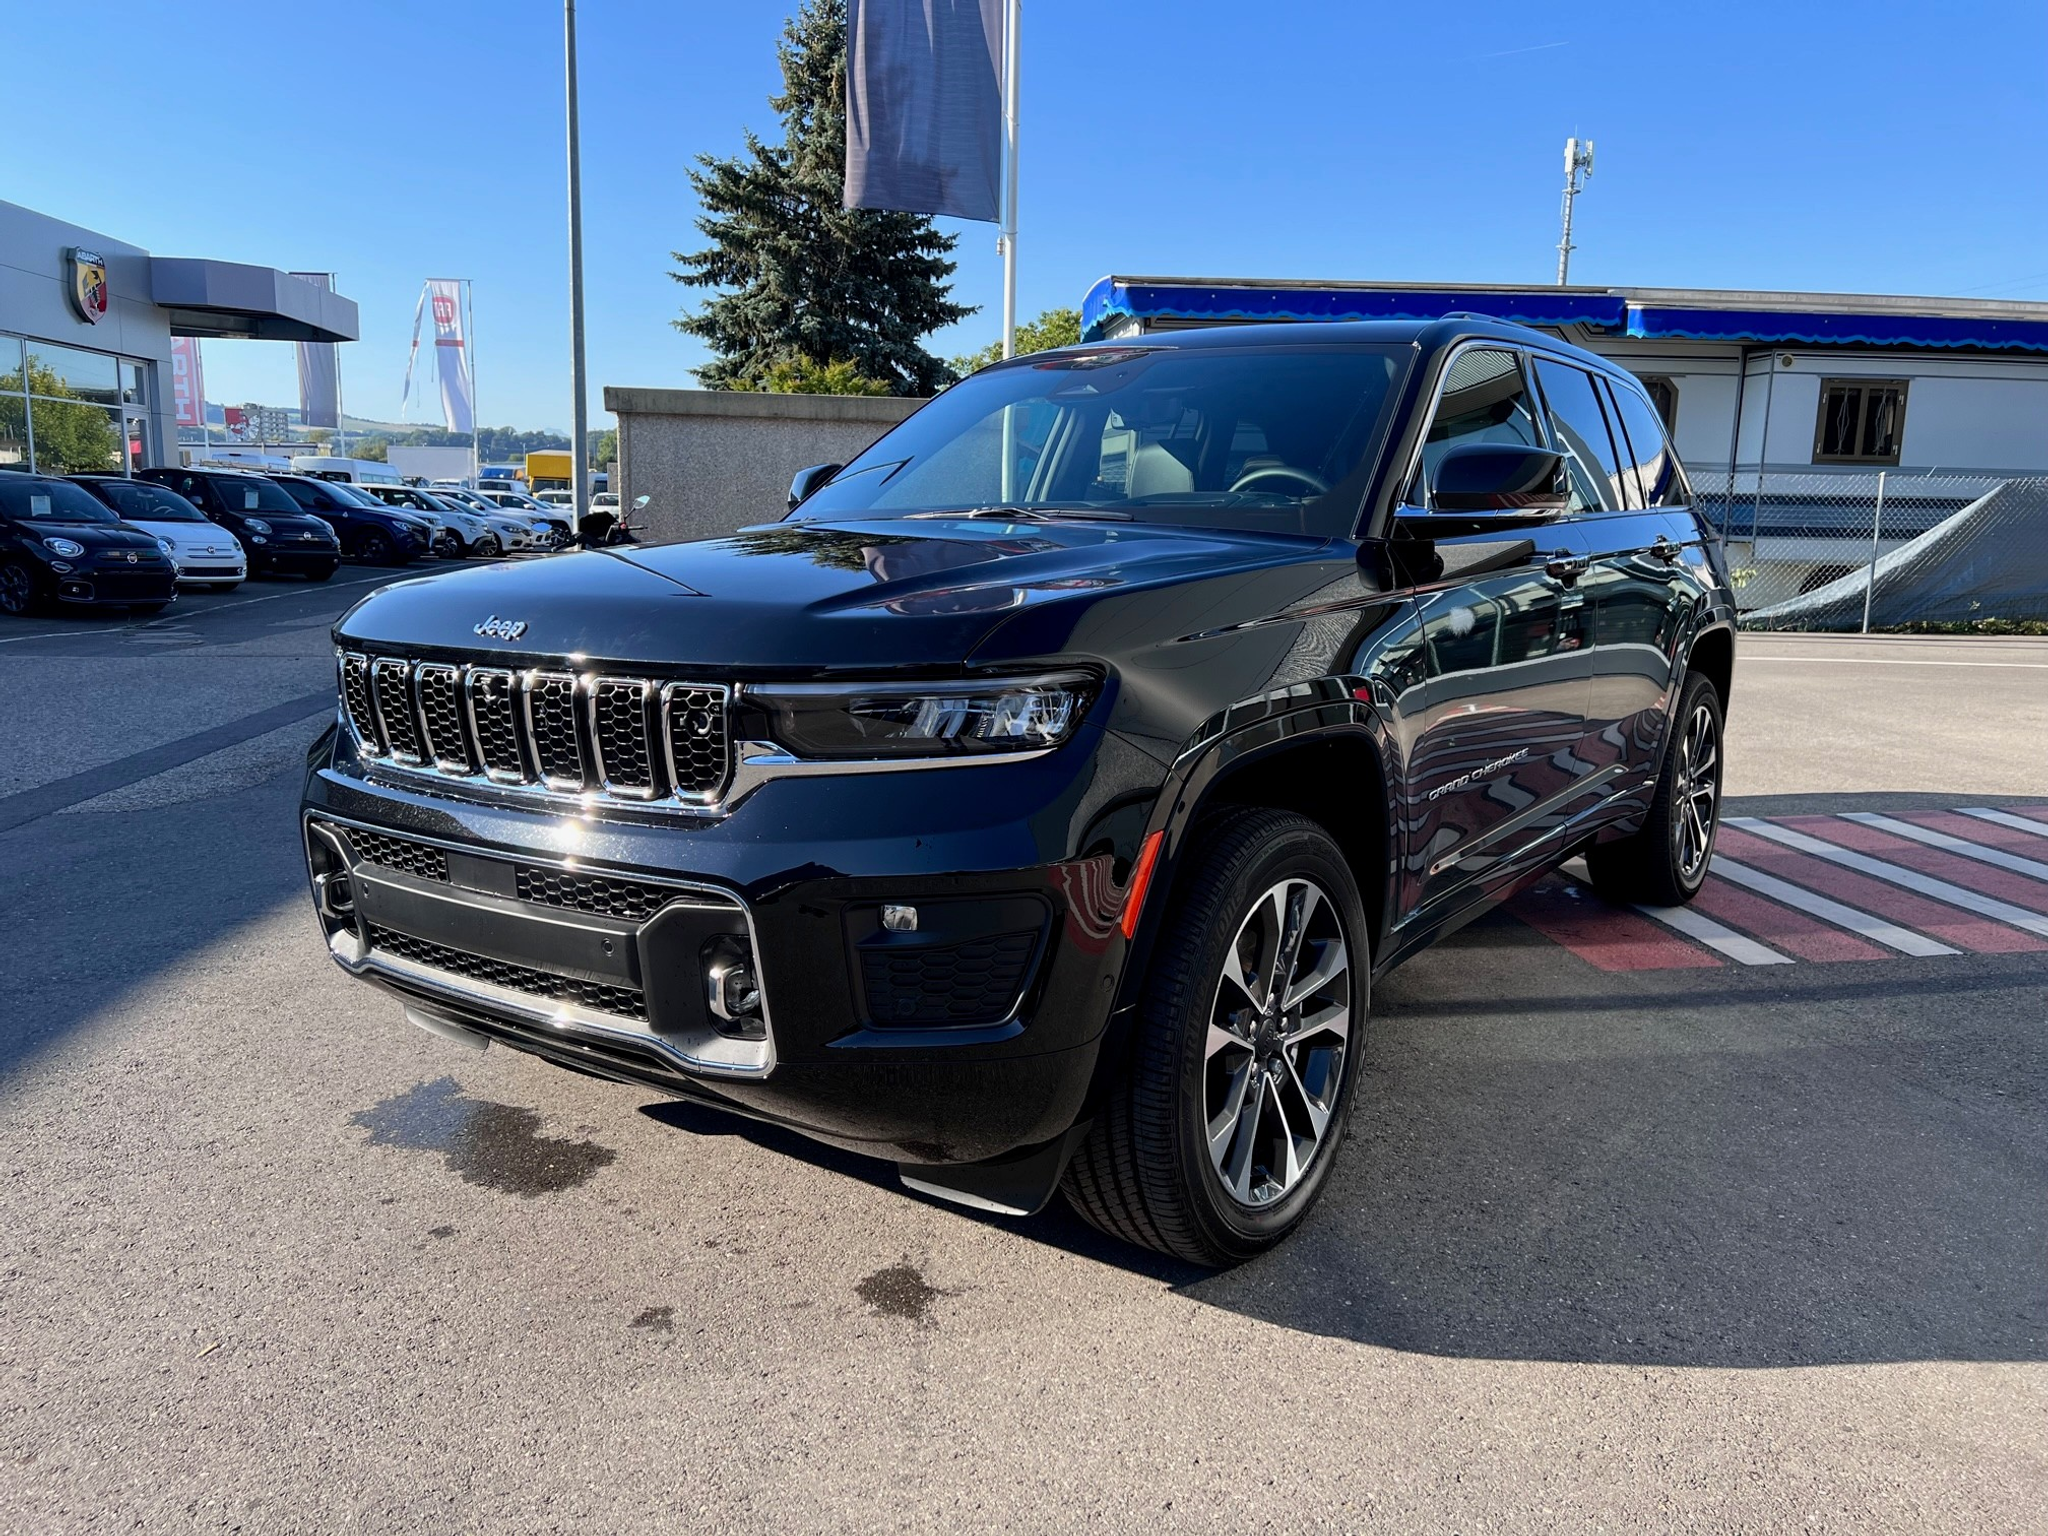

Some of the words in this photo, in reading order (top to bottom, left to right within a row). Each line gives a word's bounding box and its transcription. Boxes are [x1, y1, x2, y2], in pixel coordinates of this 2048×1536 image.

[473, 614, 527, 642] Jeep
[1428, 774, 1469, 801] GRAND
[1471, 747, 1529, 781] CHEROKEE
